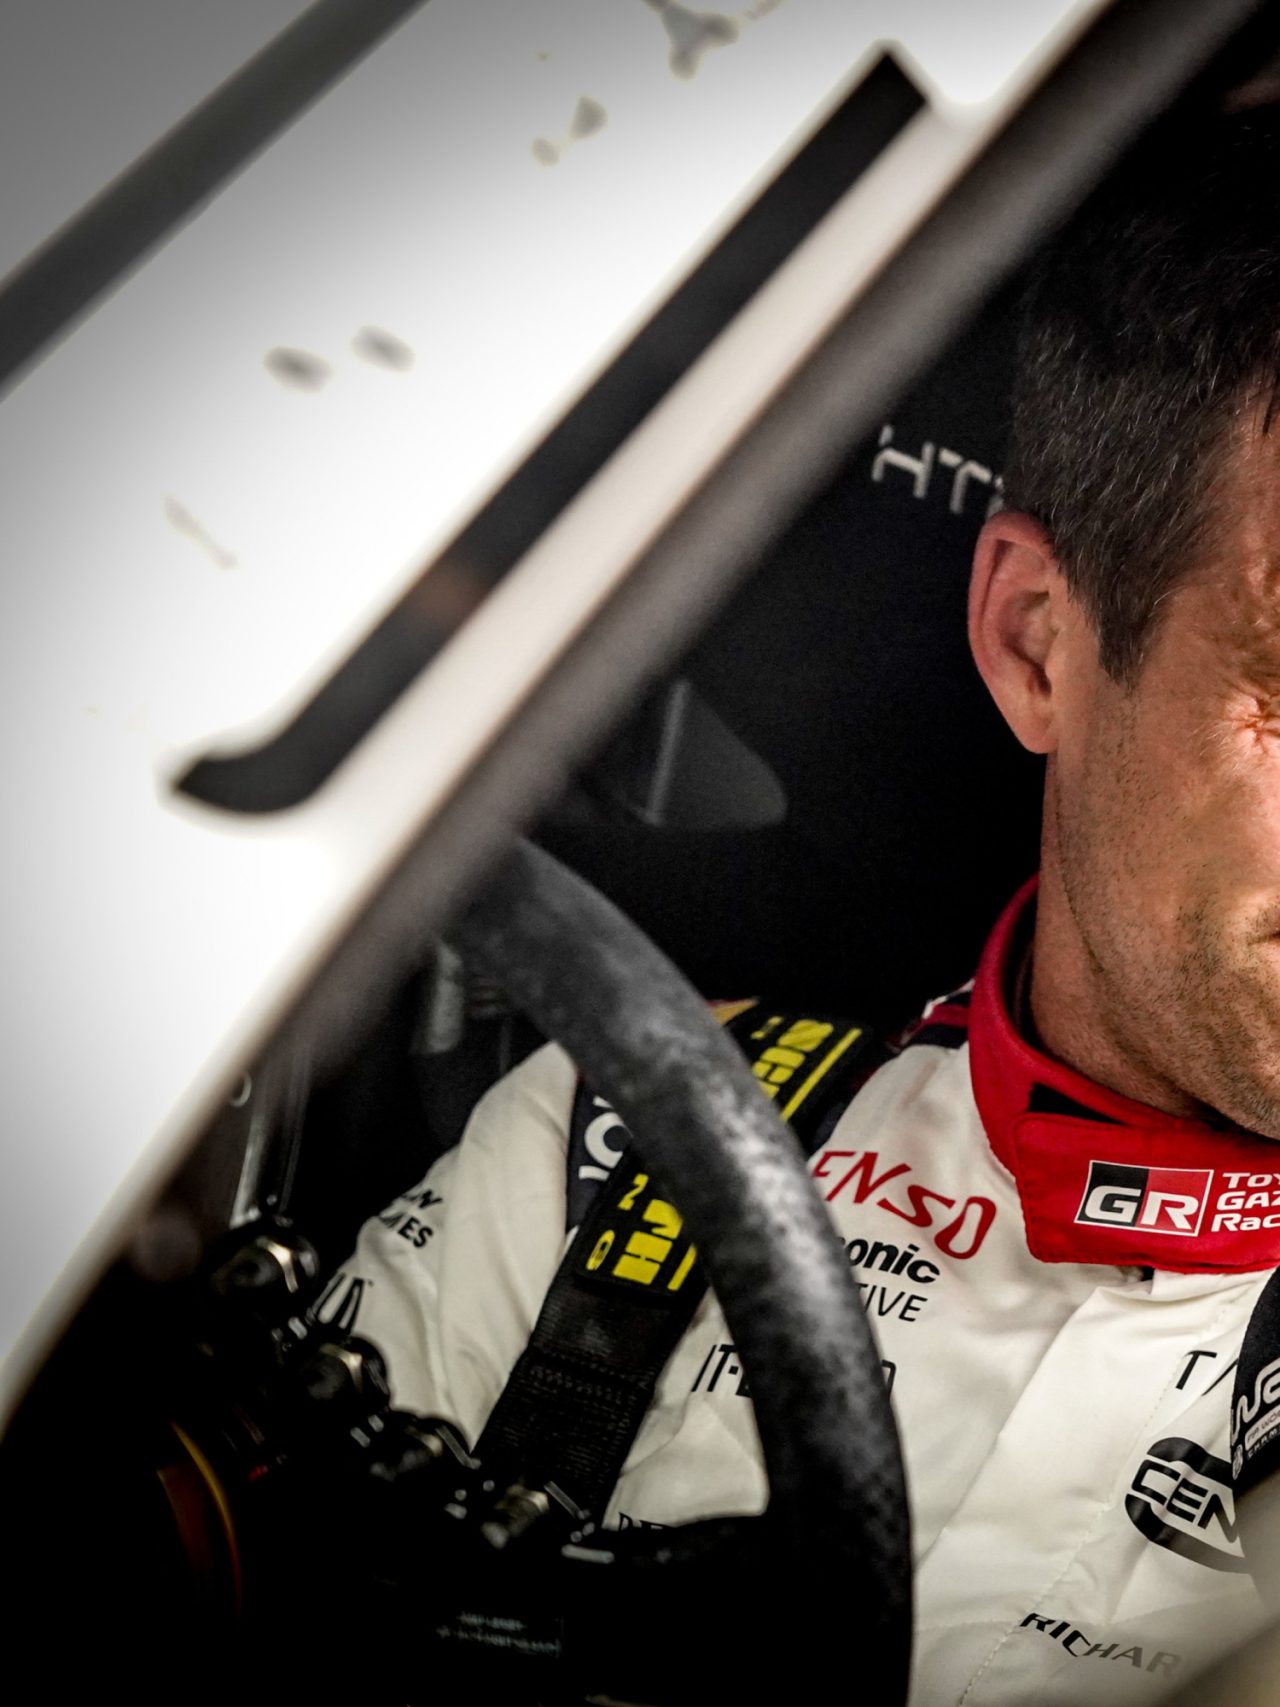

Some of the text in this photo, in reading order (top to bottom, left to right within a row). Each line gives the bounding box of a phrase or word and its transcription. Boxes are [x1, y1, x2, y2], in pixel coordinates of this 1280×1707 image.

[812, 1151, 997, 1260] ENSO
[1085, 1185, 1199, 1230] GR
[842, 1237, 940, 1283] onic
[1131, 1459, 1238, 1544] CEN
[1020, 1612, 1183, 1680] RICHAR
